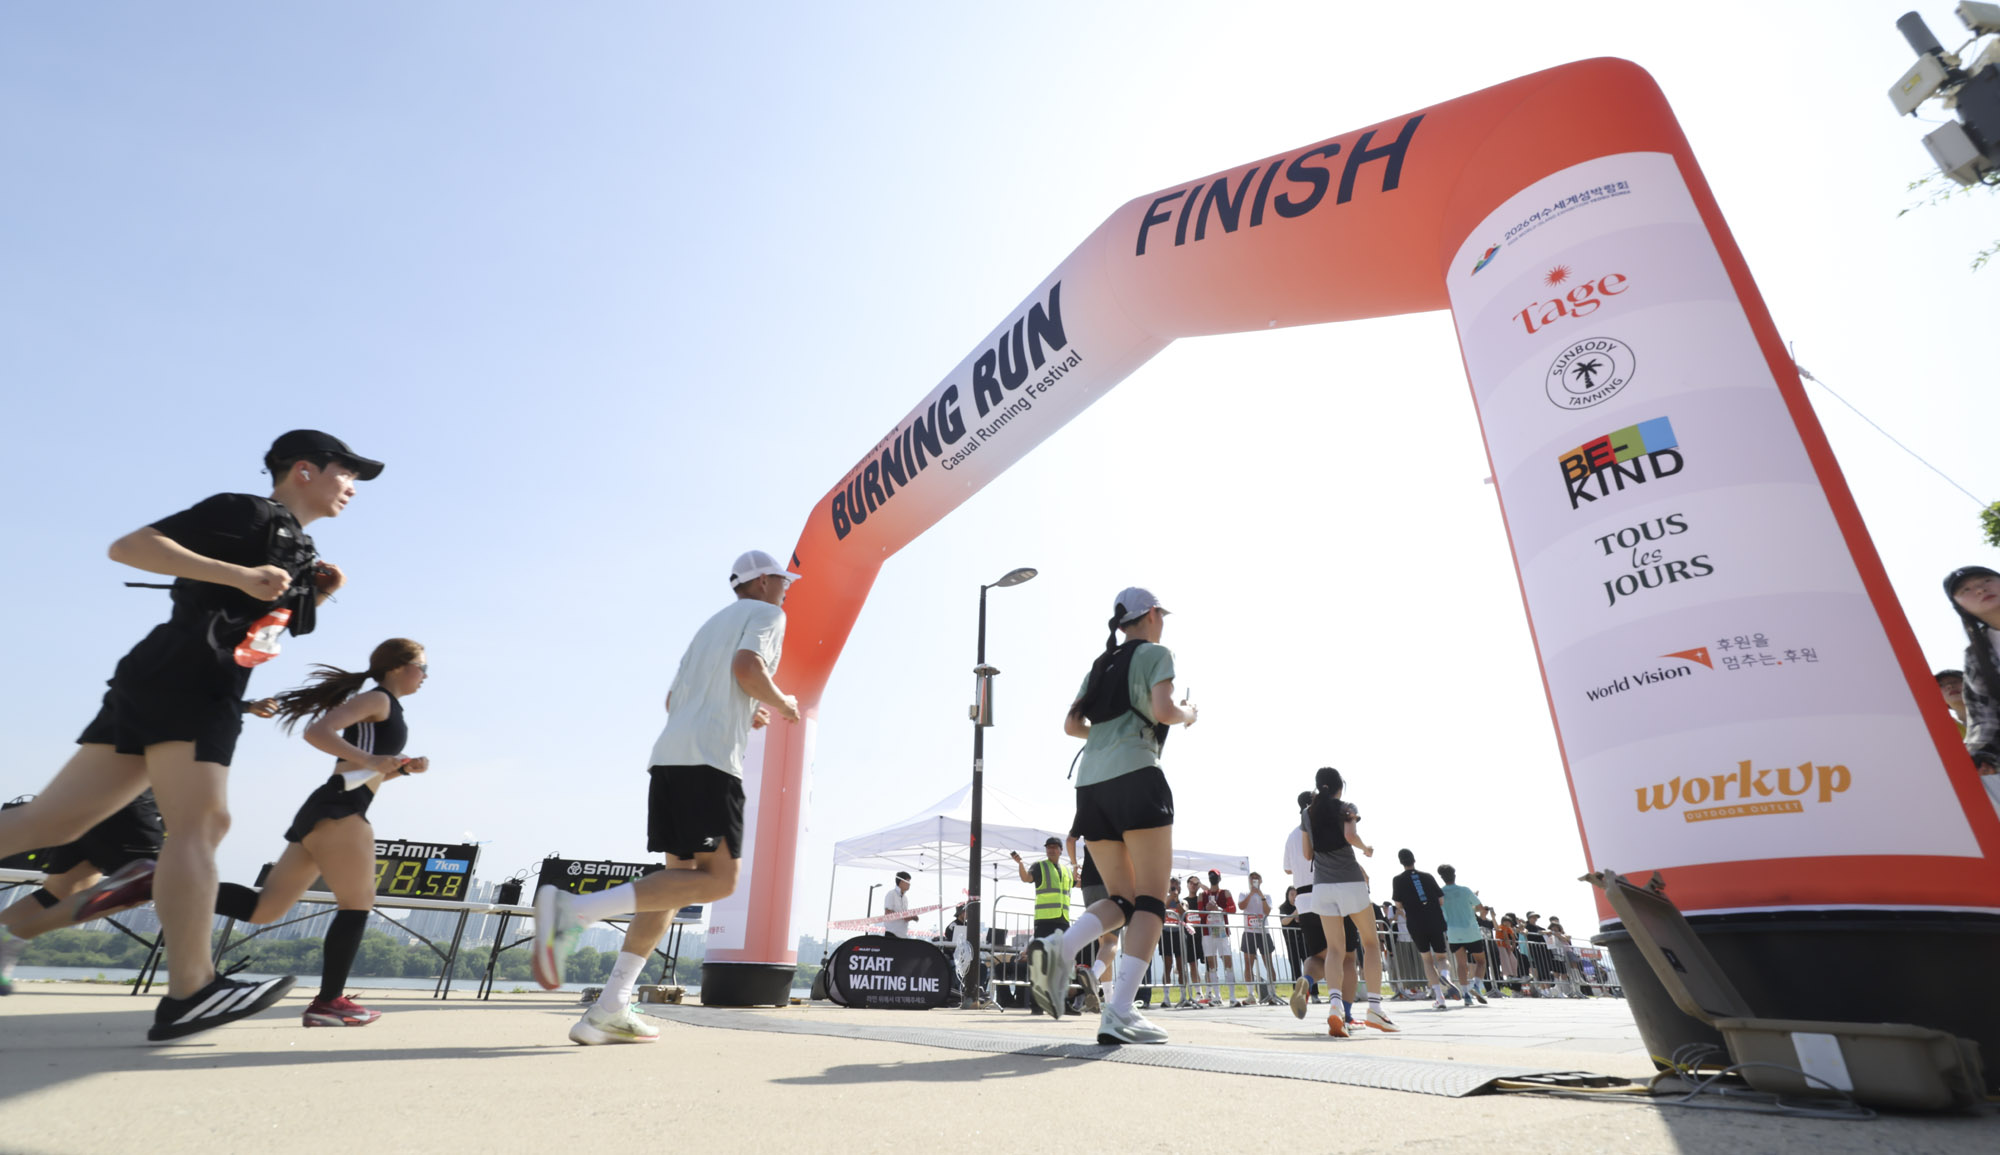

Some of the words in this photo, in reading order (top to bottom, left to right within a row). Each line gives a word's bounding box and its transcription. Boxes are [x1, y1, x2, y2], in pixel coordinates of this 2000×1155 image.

[1136, 114, 1425, 256] FINISH
[1512, 273, 1630, 334] Tage
[1552, 340, 1617, 376] SUNBODY
[1569, 377, 1623, 406] TANNING
[831, 384, 967, 541] BURNING
[973, 280, 1068, 419] RUN
[941, 436, 981, 471] Casual
[976, 397, 1032, 441] Running
[1025, 349, 1083, 399] Festival
[1566, 448, 1684, 510] KIND
[1594, 512, 1689, 556] TOUS
[1631, 547, 1663, 569] les
[1602, 554, 1715, 608] JOURS
[1716, 632, 1770, 652] 후원을
[1586, 676, 1631, 702] World
[1632, 665, 1692, 686] Vision
[1686, 806, 1745, 821] OUTDOOR
[1750, 801, 1801, 814] OUTLET
[374, 843, 448, 859] SAMIK
[434, 860, 460, 872] 7km
[583, 863, 645, 877] SAMIK
[848, 954, 894, 973] START
[848, 974, 907, 991] WAITING
[909, 976, 940, 993] LINE
